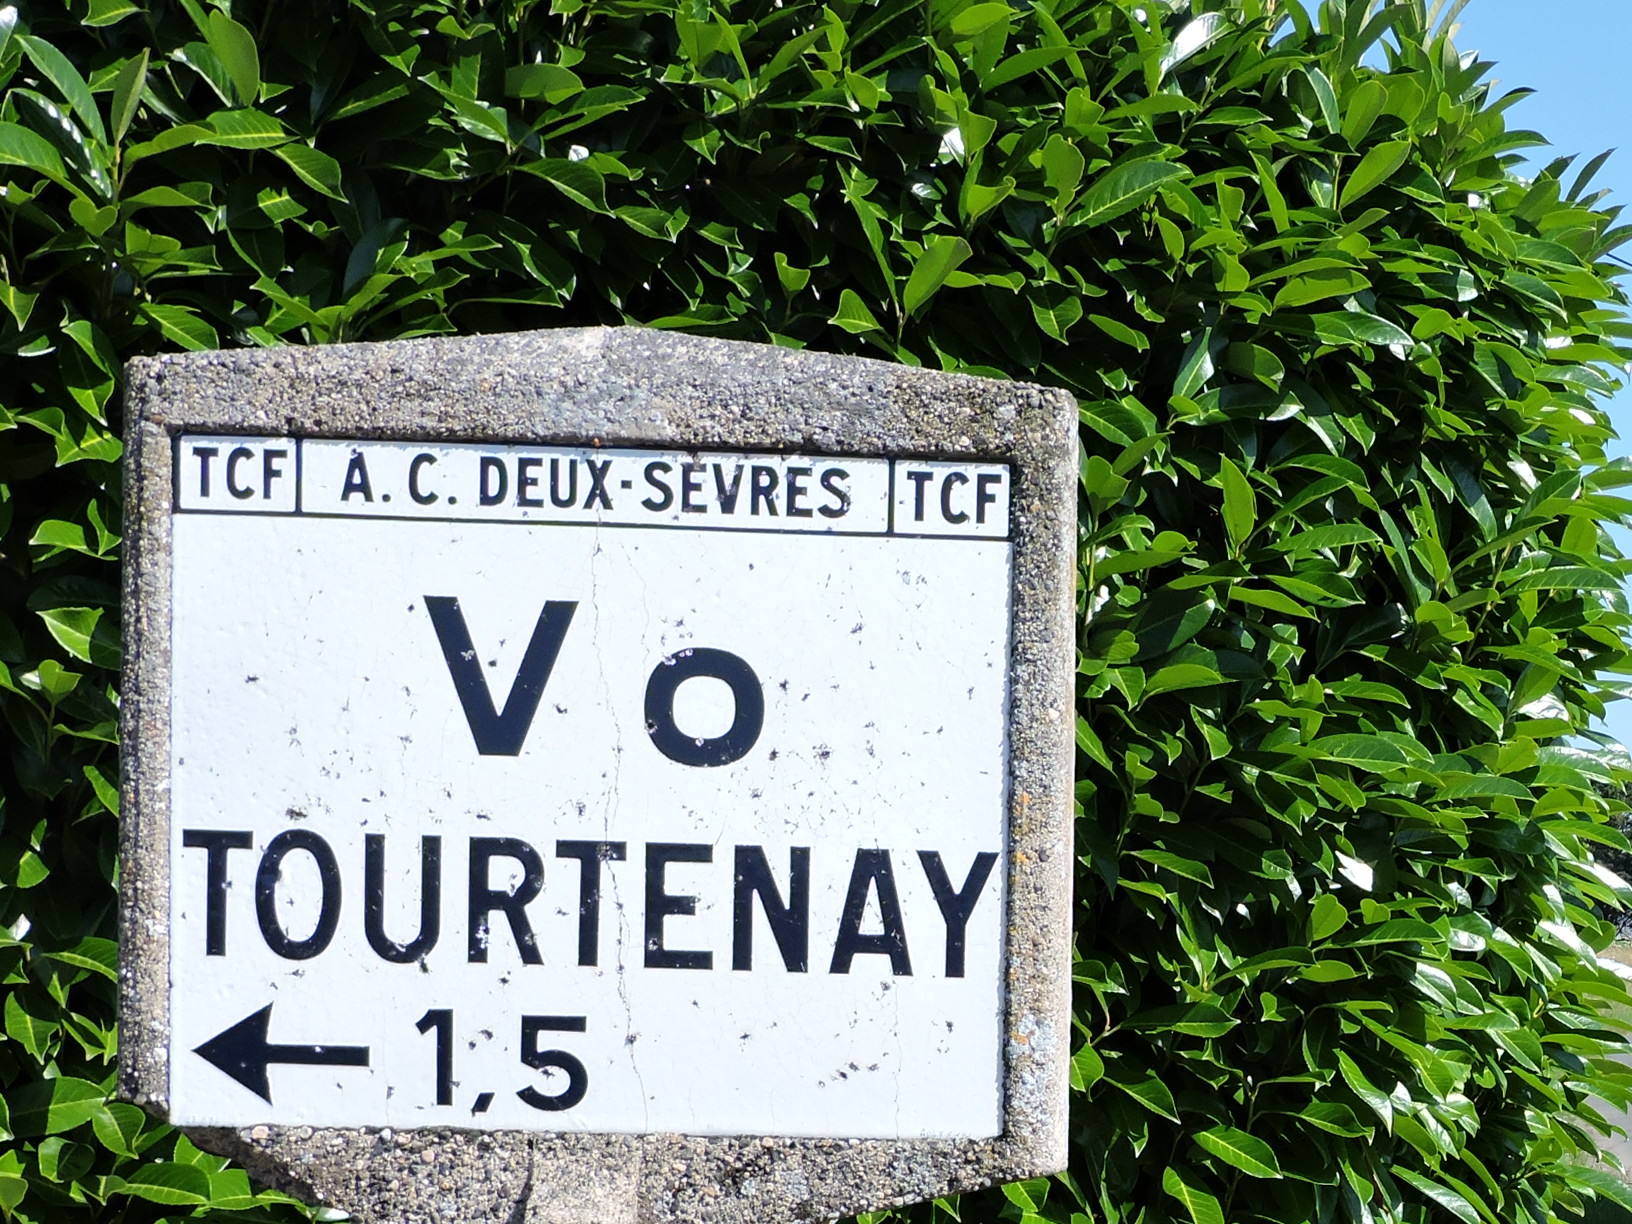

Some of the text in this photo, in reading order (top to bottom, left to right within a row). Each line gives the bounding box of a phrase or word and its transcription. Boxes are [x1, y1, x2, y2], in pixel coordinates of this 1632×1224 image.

[192, 446, 288, 500] TCF
[341, 452, 852, 520] A. C. DEUX-SEVRES
[907, 471, 1002, 525] TCF
[182, 829, 1000, 978] TOURTENAY
[415, 1009, 589, 1116] 1,5
